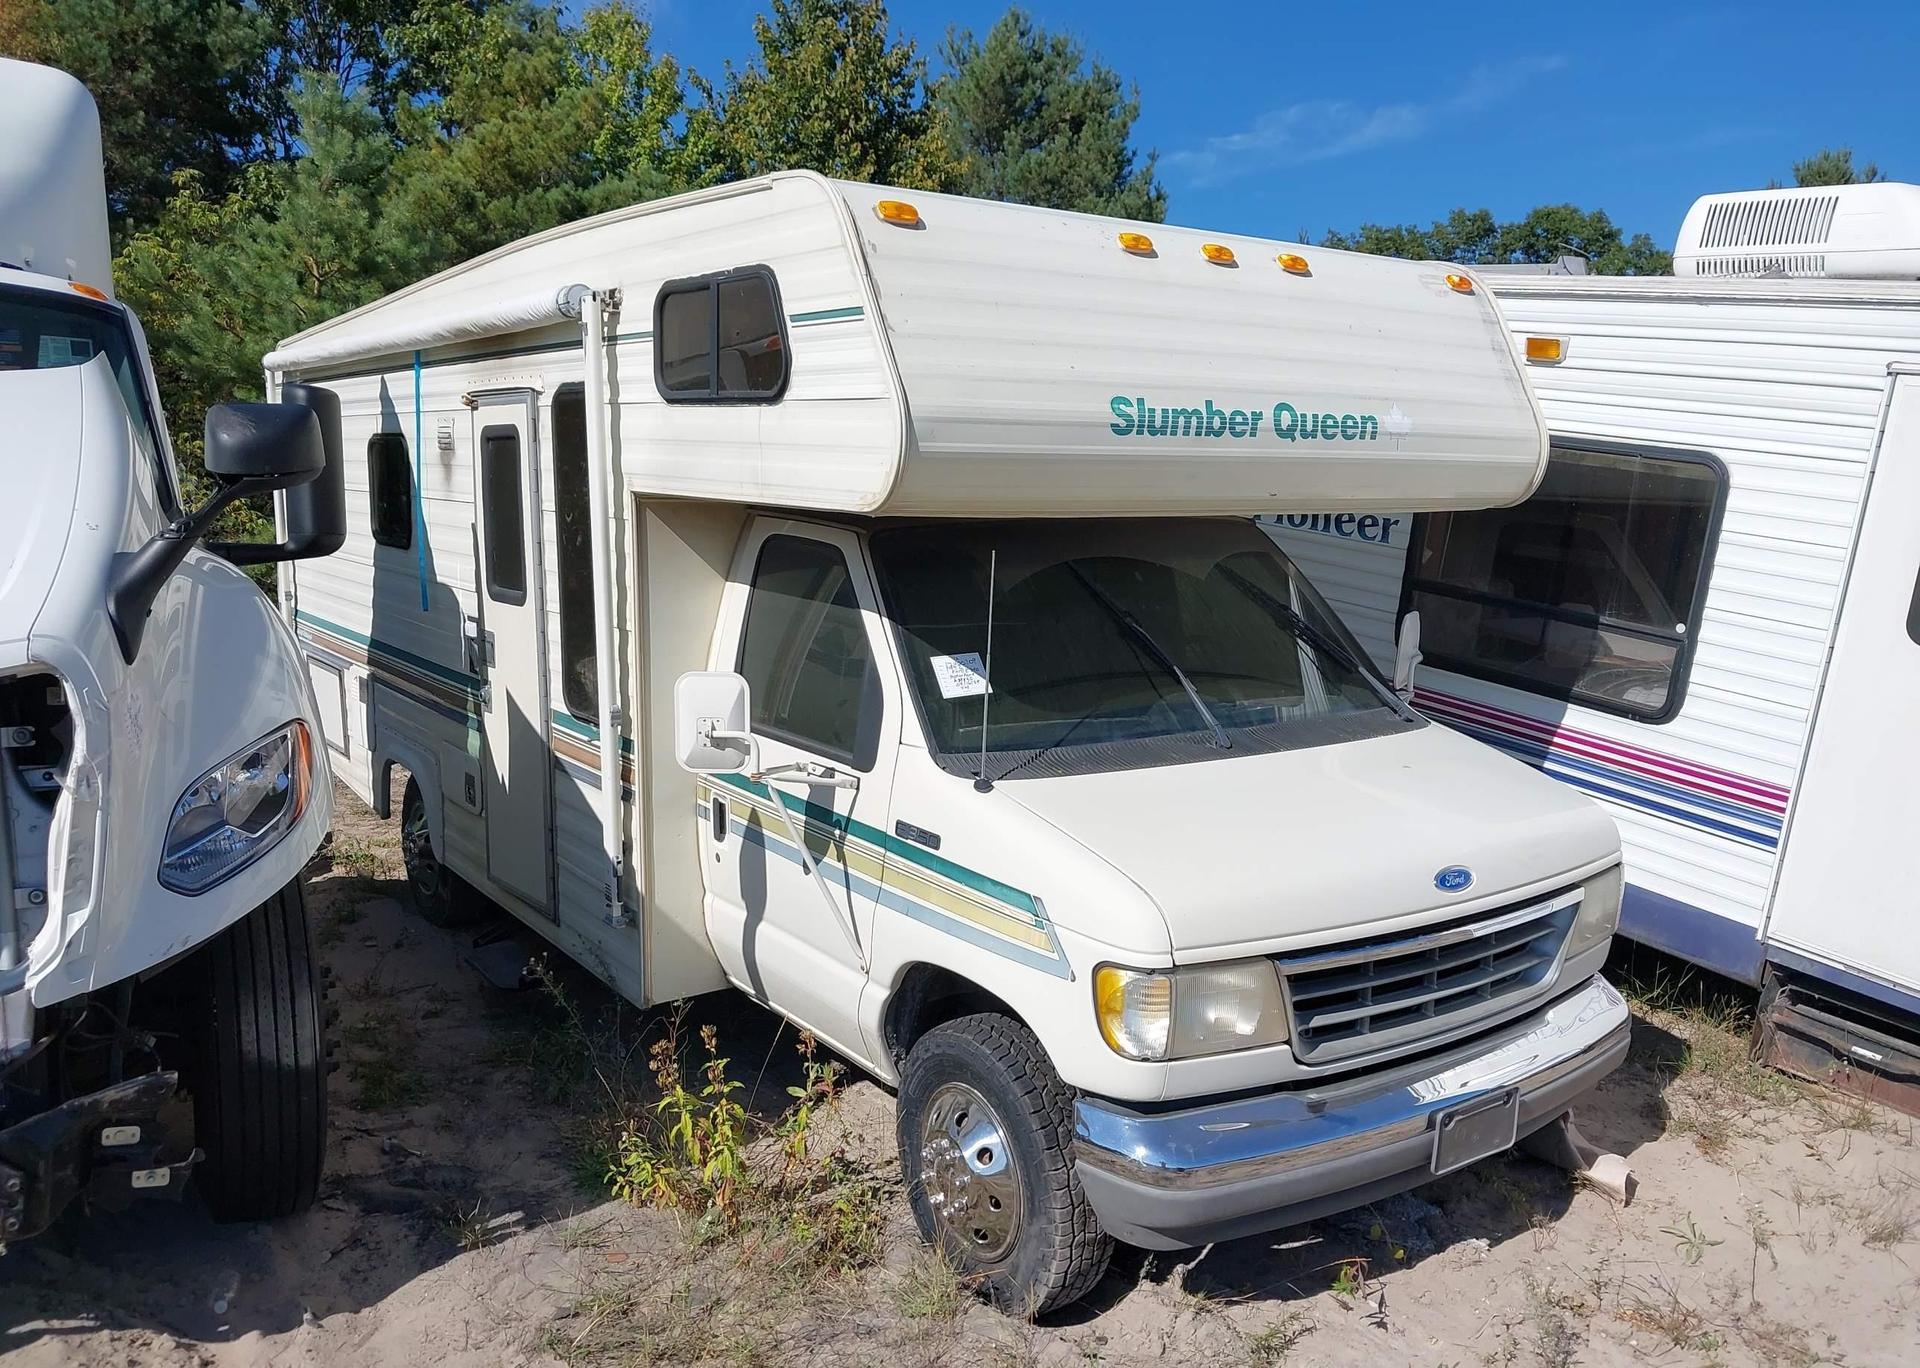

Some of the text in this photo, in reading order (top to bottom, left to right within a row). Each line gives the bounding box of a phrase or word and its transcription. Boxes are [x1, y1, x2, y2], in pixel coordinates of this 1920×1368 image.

[1109, 395, 1379, 442] Slumber Queen
[1253, 512, 1400, 544] oneer
[1445, 871, 1465, 887] Ford
